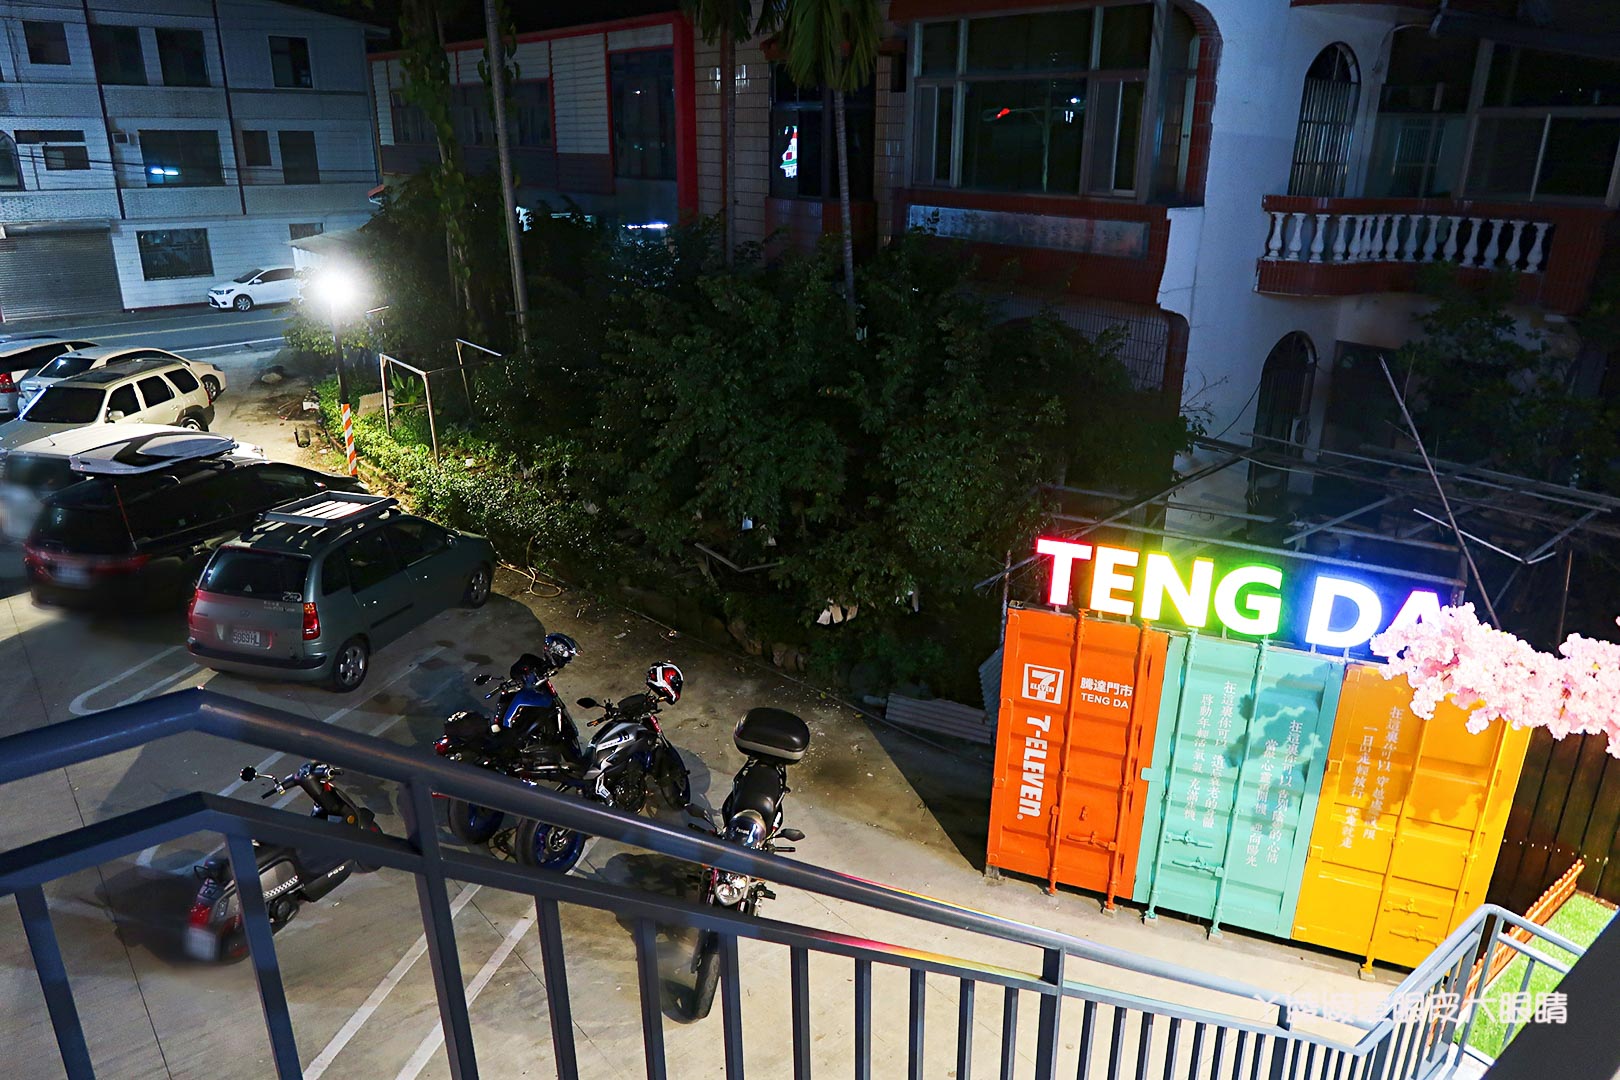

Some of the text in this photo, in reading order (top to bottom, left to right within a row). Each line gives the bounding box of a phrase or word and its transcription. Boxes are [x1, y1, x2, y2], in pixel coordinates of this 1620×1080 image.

[1037, 539, 1283, 636] TENG
[1080, 677, 1133, 697] 騰達門市
[1081, 692, 1129, 709] TENG DA
